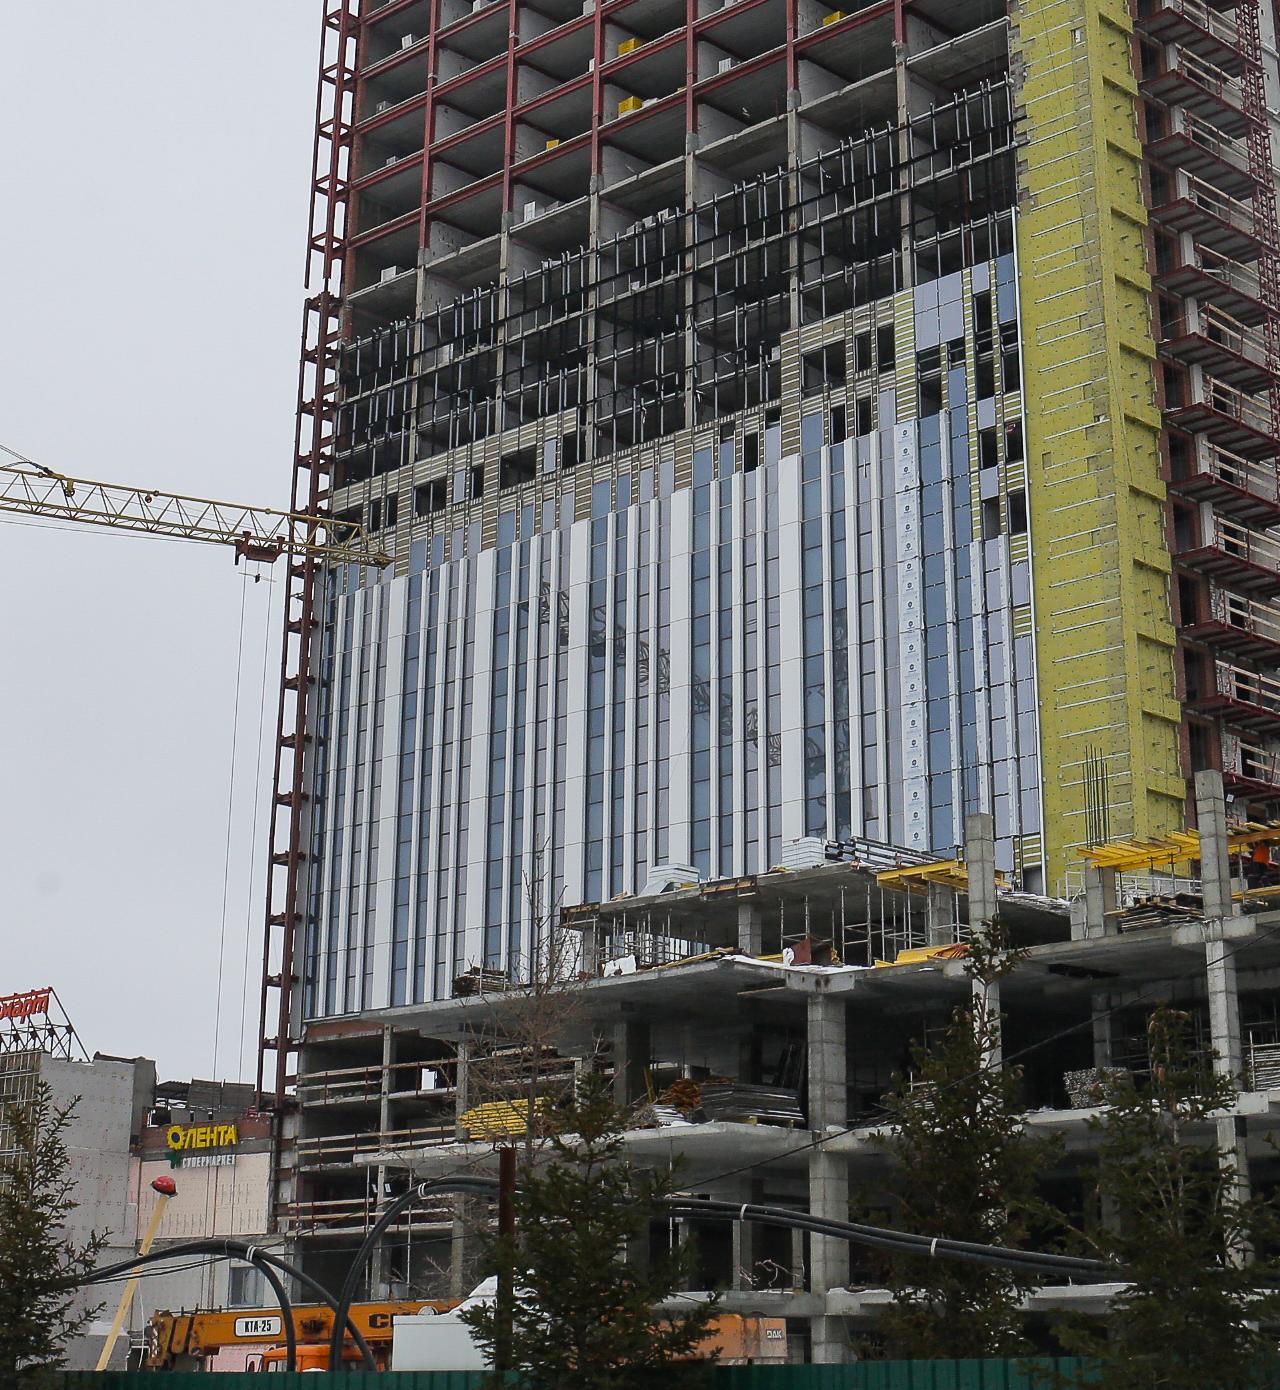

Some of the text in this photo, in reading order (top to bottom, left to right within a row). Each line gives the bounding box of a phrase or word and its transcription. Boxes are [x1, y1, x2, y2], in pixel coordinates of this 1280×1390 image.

[184, 1124, 238, 1149] ЛЕНТА
[182, 1154, 236, 1169] СУПЕРМАРКЕТ
[244, 1319, 272, 1333] КТА-25
